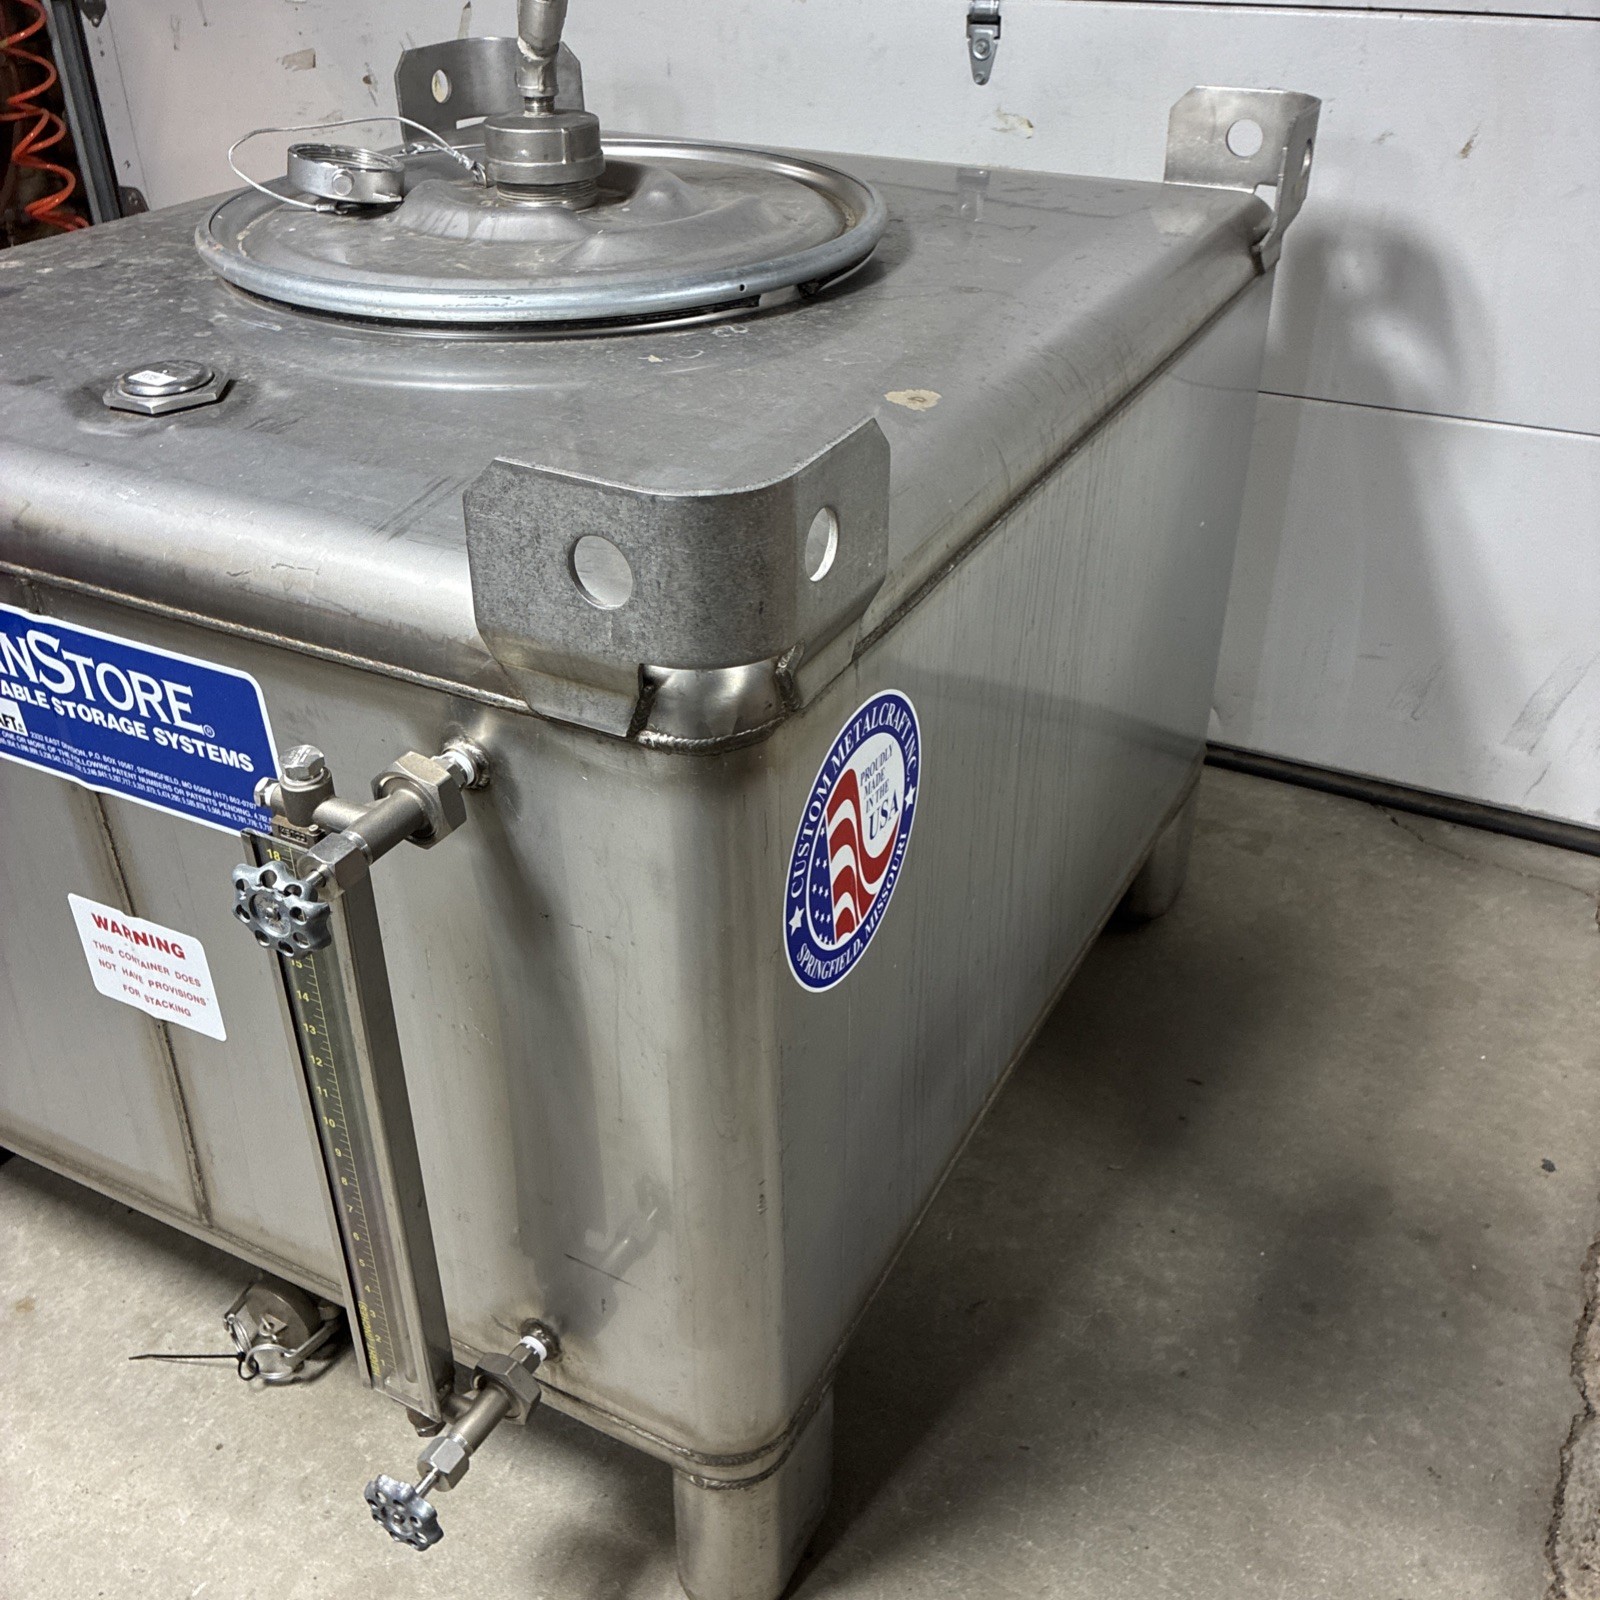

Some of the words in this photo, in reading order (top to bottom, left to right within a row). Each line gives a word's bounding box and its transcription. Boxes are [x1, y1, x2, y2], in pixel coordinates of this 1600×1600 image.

[0, 679, 50, 710] ABLE
[51, 696, 150, 740] STORAGE
[153, 726, 254, 773] SYSTEMS
[47, 743, 57, 753] OF
[57, 748, 70, 759] THE
[70, 752, 111, 773] FOLLOWING
[111, 766, 137, 781] PATENT
[137, 774, 173, 793] NUMBERS
[174, 786, 185, 796] OR
[185, 789, 217, 807] PATENTS
[102, 754, 117, 765] BOX
[136, 766, 181, 787] SPRINGFIELD,
[181, 780, 192, 790] MO
[860, 743, 894, 787] PROUDLY
[864, 767, 885, 795] MADE
[790, 773, 832, 898] CUSTOM
[831, 702, 912, 775] METALCRAFT
[904, 732, 917, 782] INC.
[865, 797, 874, 814] IN
[874, 778, 890, 804] THE
[869, 789, 899, 840] USA
[267, 848, 281, 861] 18
[796, 938, 864, 980] SPRINGFIELD,
[865, 832, 907, 938] MISSOURI
[91, 912, 186, 960] WARNING
[92, 940, 114, 954] THIS
[119, 950, 170, 976] CONTAINER
[174, 971, 201, 987] DOES
[98, 959, 117, 972] NOT
[122, 966, 144, 984] HAVE
[148, 979, 207, 1006] PROVISIONS
[122, 984, 141, 998] FOR
[144, 994, 192, 1017] STACKING
[296, 990, 310, 1002] 14
[303, 1023, 317, 1035] 13
[310, 1055, 324, 1067] 12
[316, 1086, 329, 1098] 11
[323, 1116, 336, 1128] 10
